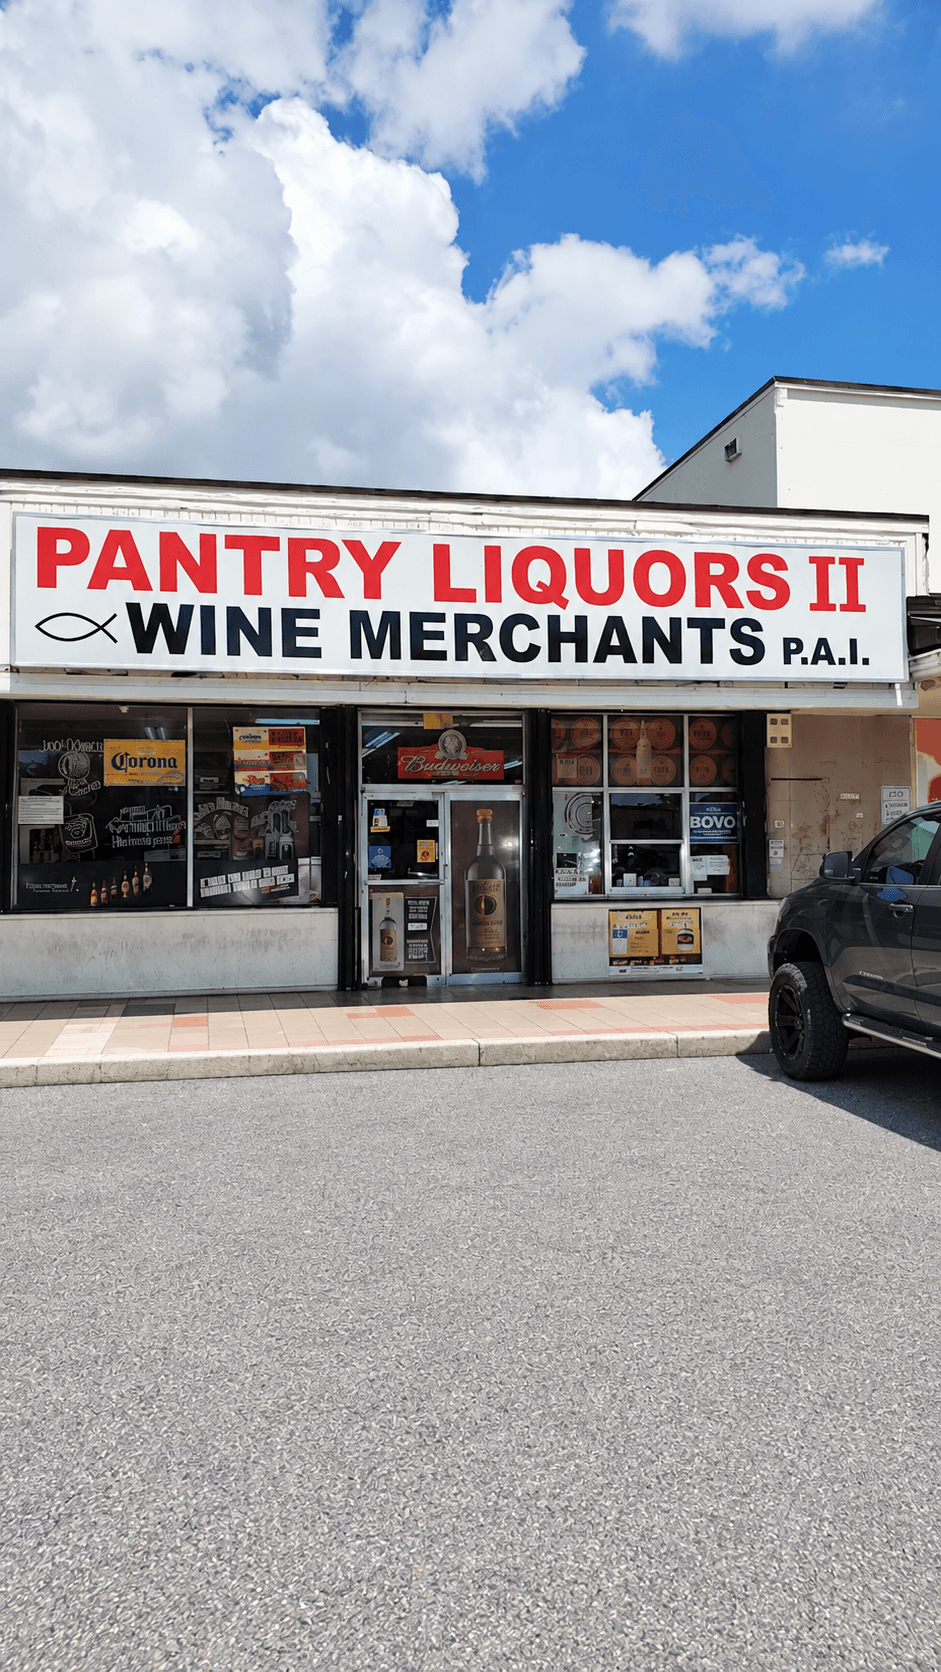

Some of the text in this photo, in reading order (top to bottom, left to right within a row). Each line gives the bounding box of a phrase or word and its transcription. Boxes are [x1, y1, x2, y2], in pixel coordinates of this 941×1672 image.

[37, 527, 866, 612] PANTRY LIQUORS II
[126, 602, 869, 665] WINE MERCHANTS P.A.I.
[111, 752, 178, 773] Corona
[401, 755, 500, 773] Budweiser
